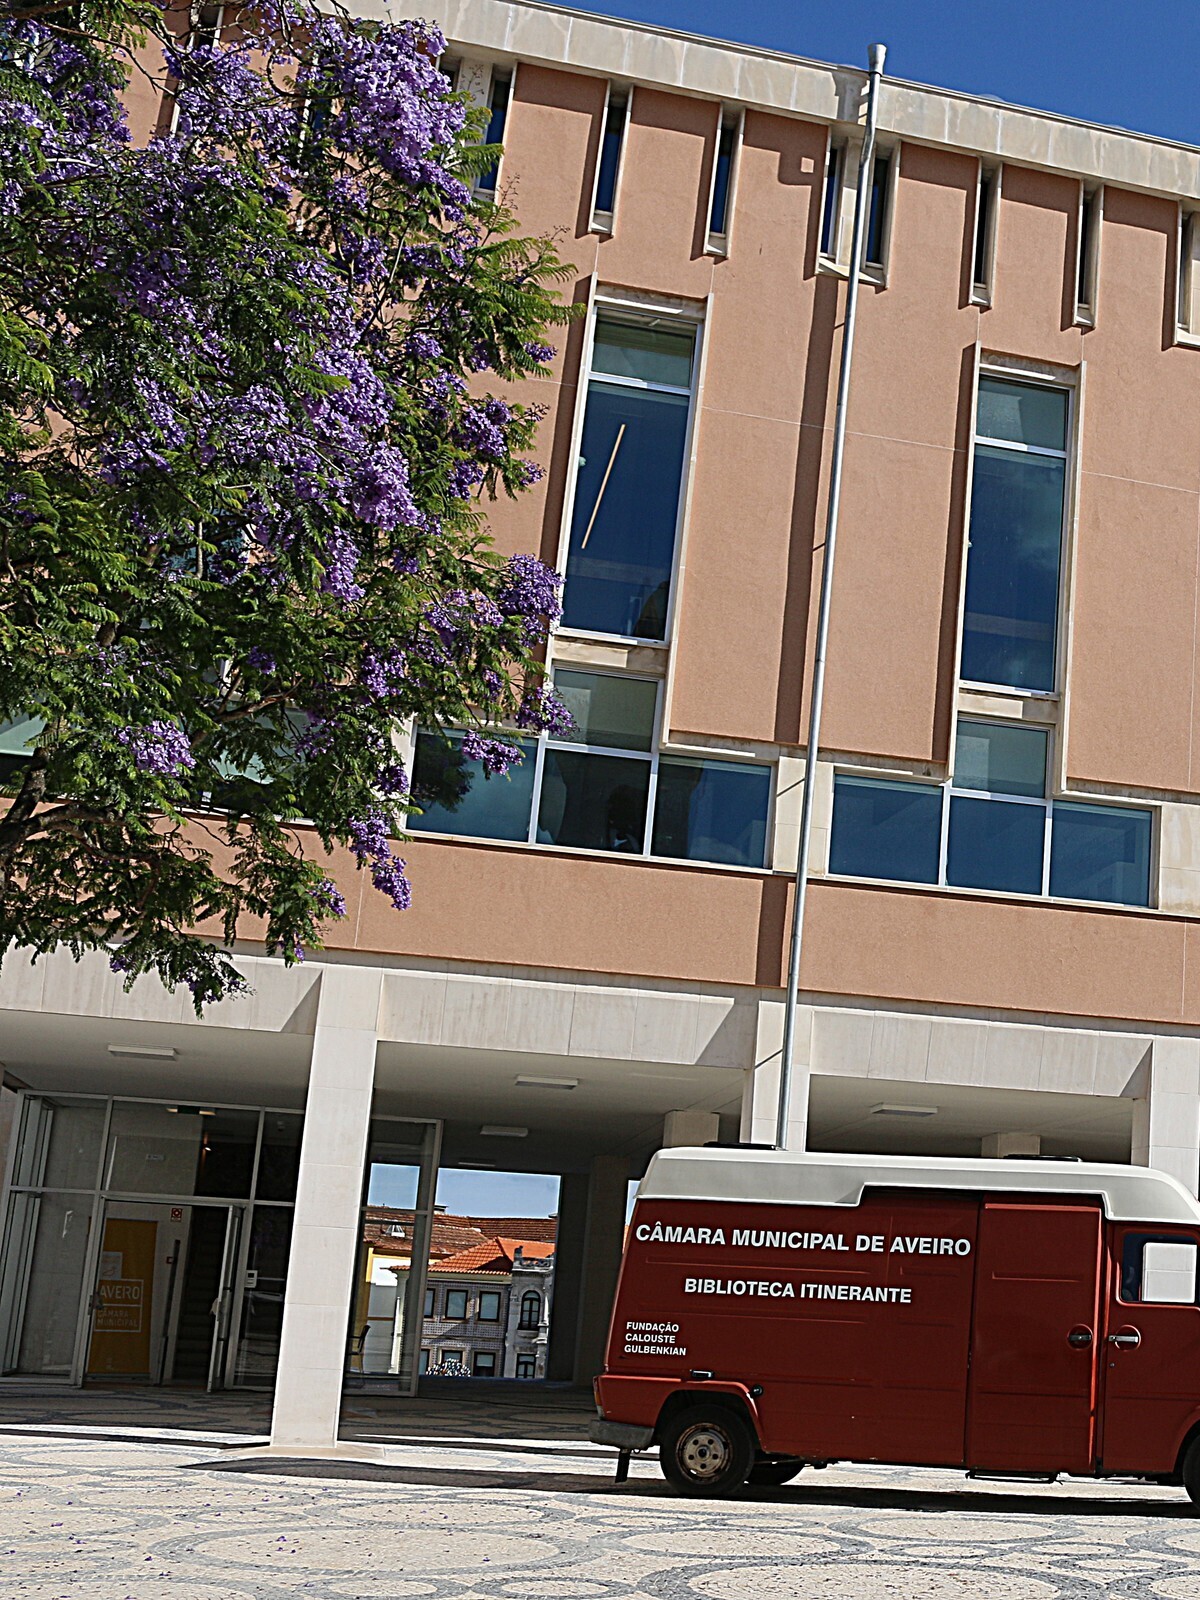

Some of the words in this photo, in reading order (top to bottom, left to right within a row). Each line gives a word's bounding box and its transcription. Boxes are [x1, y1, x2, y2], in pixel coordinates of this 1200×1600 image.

[636, 1221, 726, 1245] CÂMARA
[732, 1229, 850, 1251] MUNICIPAL
[856, 1235, 885, 1252] DE
[890, 1236, 971, 1256] AVEIRO
[684, 1278, 795, 1298] BIBLIOTECA
[800, 1284, 912, 1303] ITINERANTE
[626, 1322, 679, 1333] FUNDAÇÃO
[625, 1333, 676, 1344] CALOUSTE
[624, 1345, 687, 1356] GULBENKIAN
